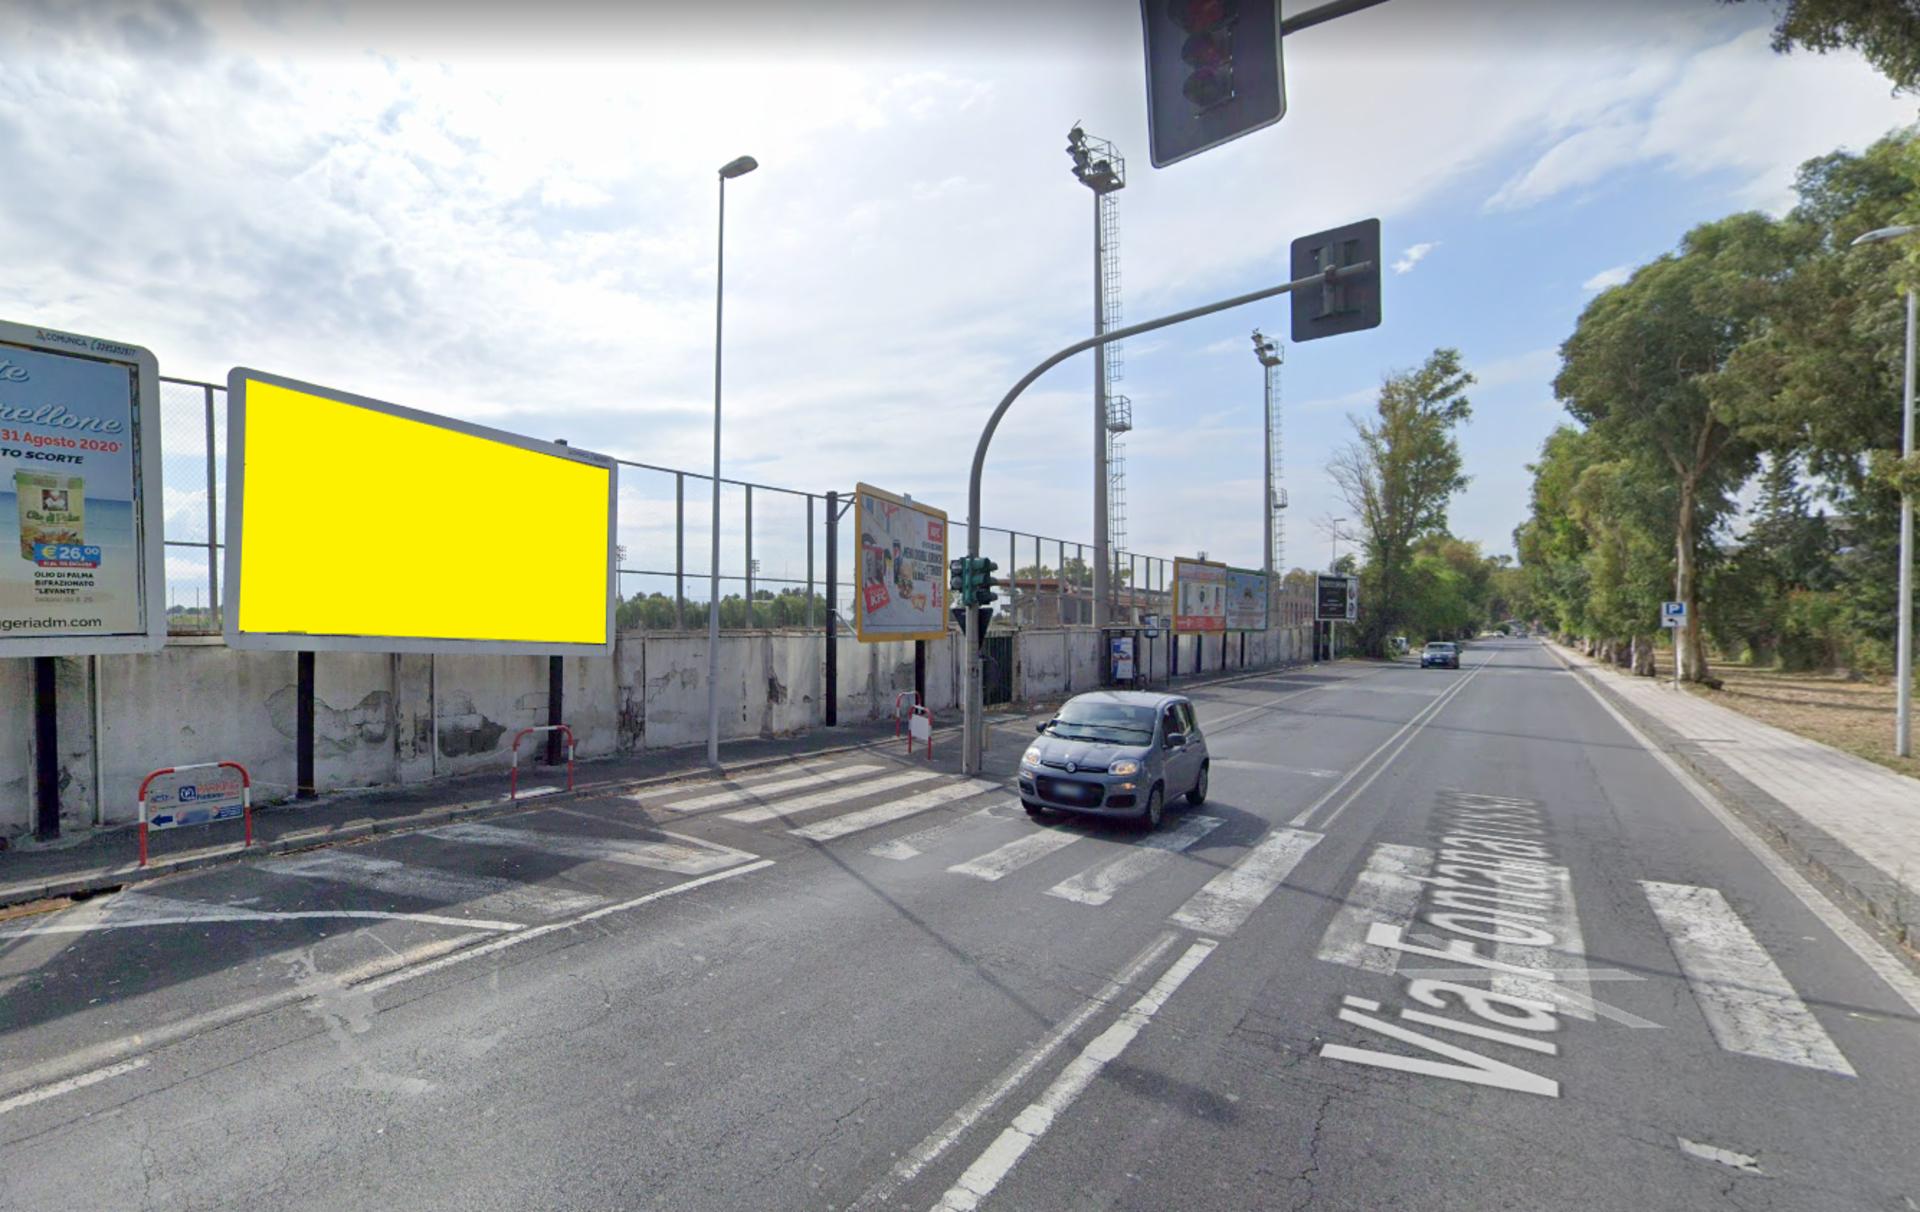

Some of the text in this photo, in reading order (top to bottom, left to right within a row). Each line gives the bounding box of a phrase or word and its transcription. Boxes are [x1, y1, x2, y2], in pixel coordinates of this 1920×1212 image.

[1, 428, 20, 442] 31
[24, 431, 76, 449] Agosto
[0, 448, 84, 465] TO SCORTE
[34, 571, 56, 579] OLIO
[66, 572, 94, 580] PALMA
[0, 616, 102, 632] geriadm.com
